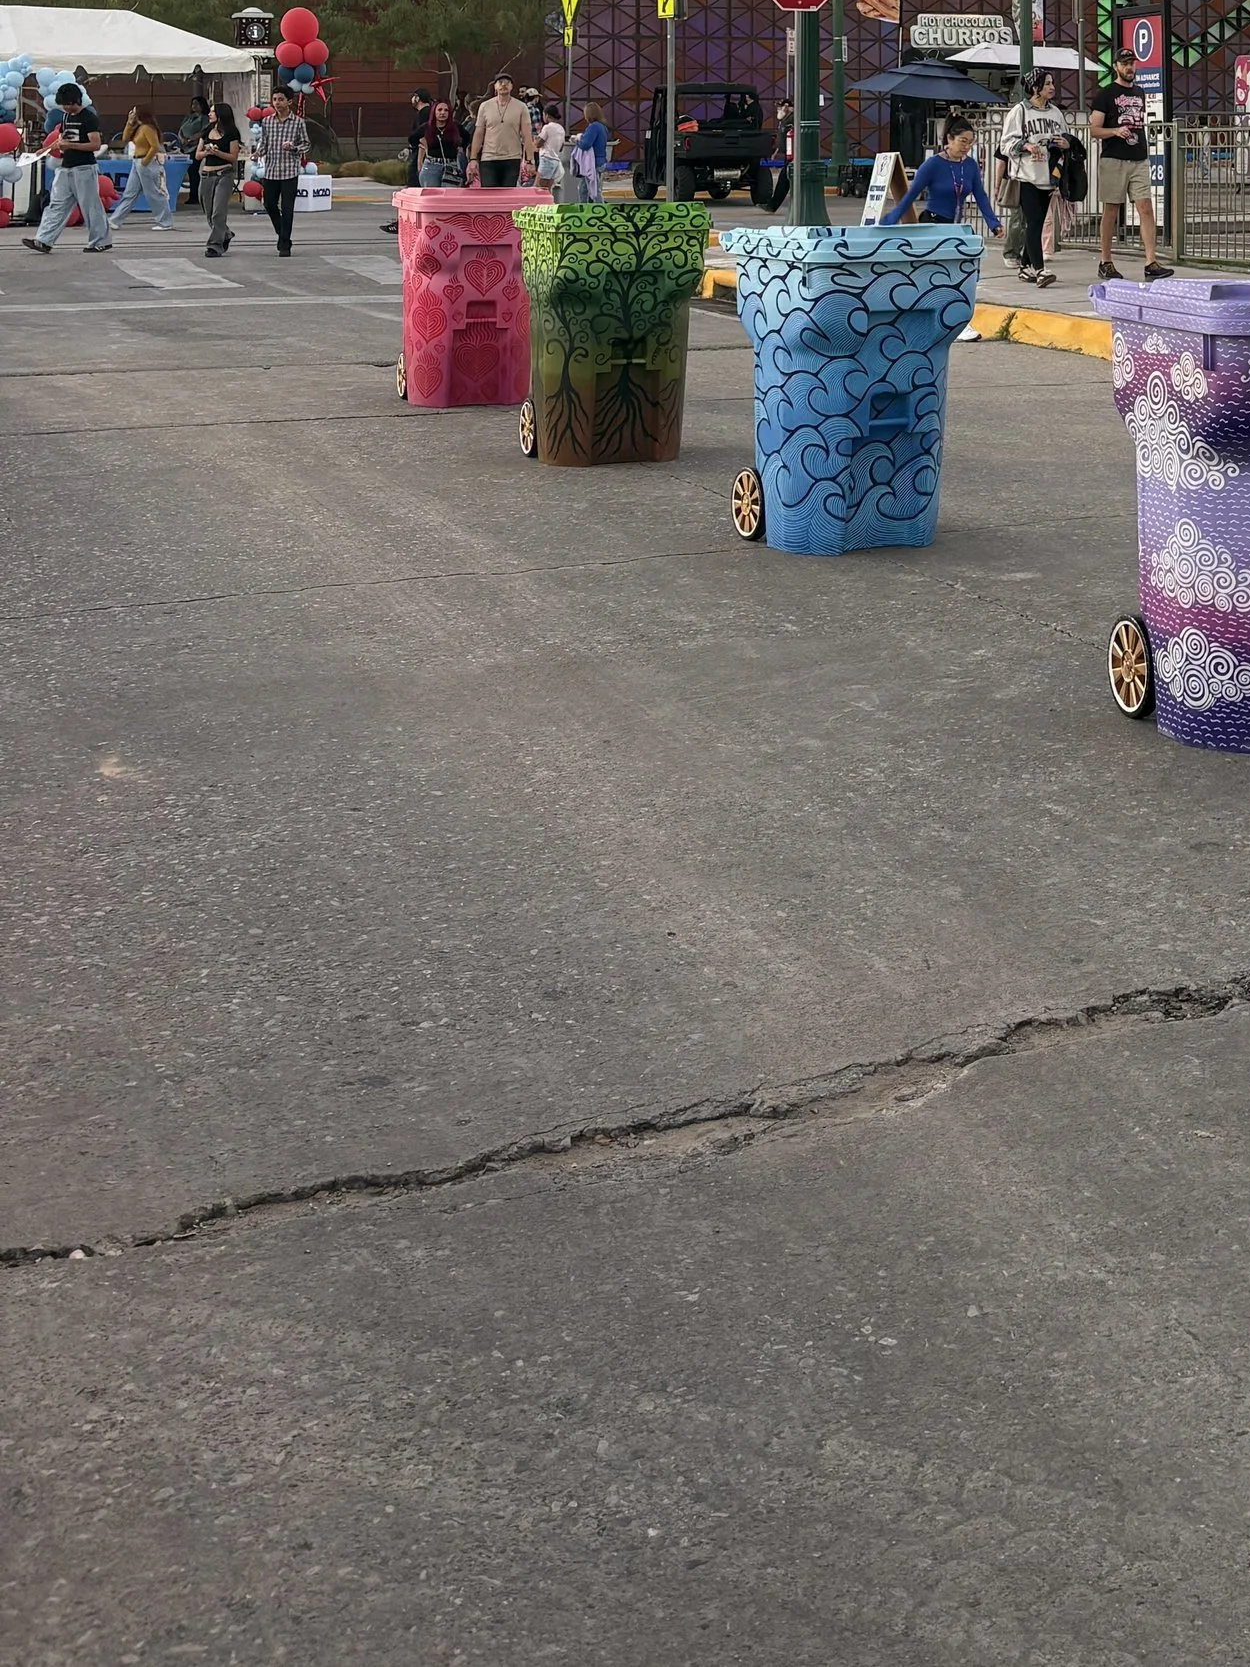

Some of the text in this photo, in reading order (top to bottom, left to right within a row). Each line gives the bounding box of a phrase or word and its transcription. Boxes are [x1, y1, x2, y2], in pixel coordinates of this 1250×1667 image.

[921, 17, 1002, 27] HOT CHOCOLATE
[914, 29, 1012, 45] CHURROS
[1138, 29, 1149, 52] P
